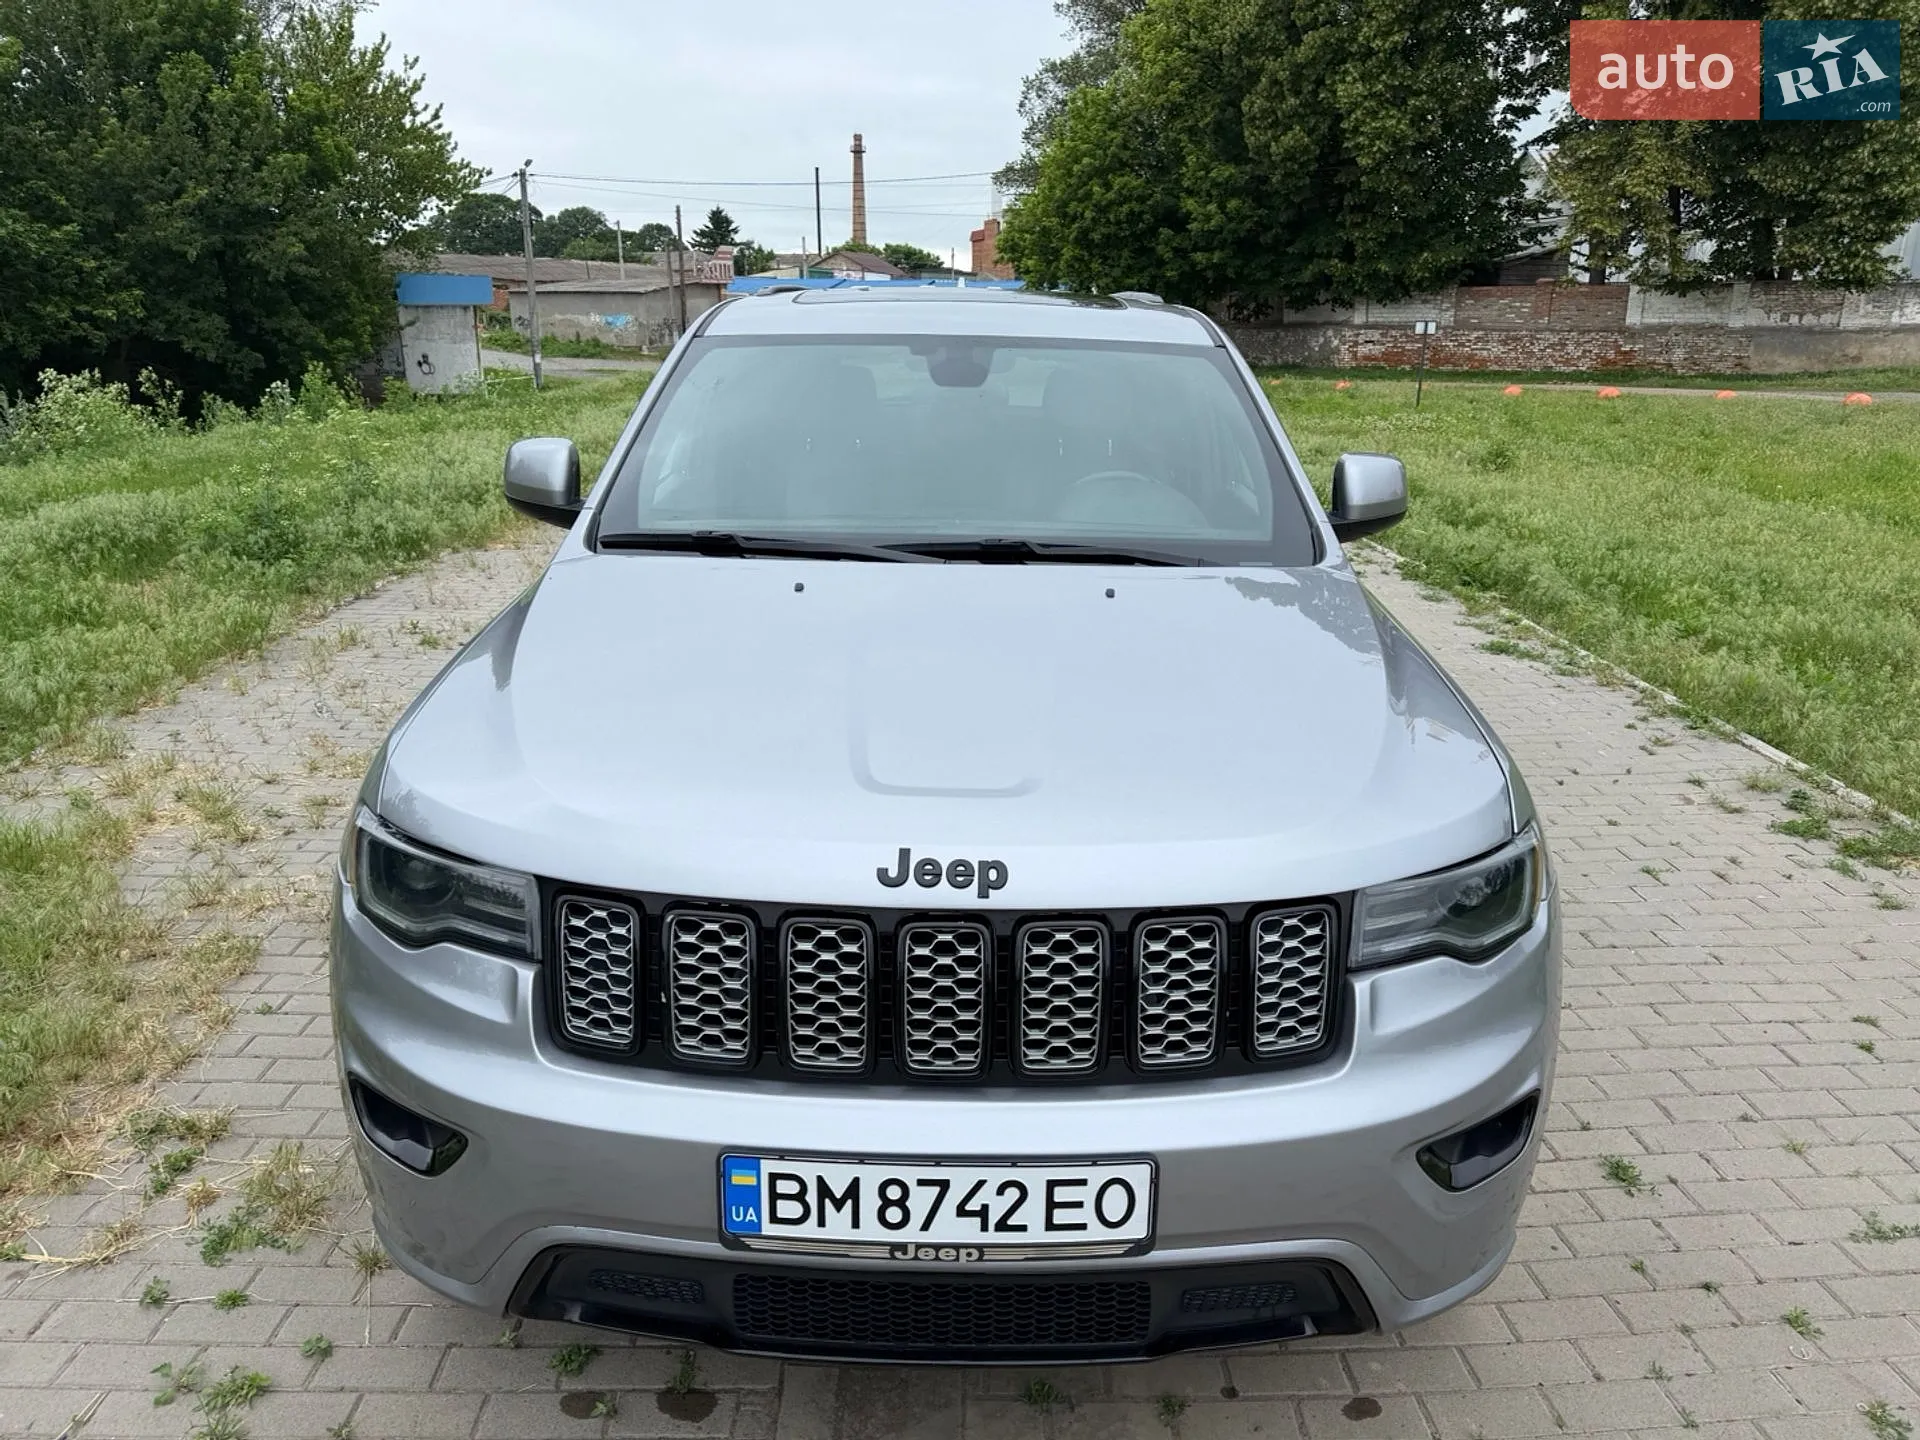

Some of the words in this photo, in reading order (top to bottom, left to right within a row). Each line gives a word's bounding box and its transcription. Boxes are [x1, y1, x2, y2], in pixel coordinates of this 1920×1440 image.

[876, 847, 1009, 899] Jeep
[731, 1205, 758, 1223] UA
[767, 1171, 860, 1230] BM
[876, 1177, 1029, 1232] 8742
[893, 1243, 980, 1263] Jeep
